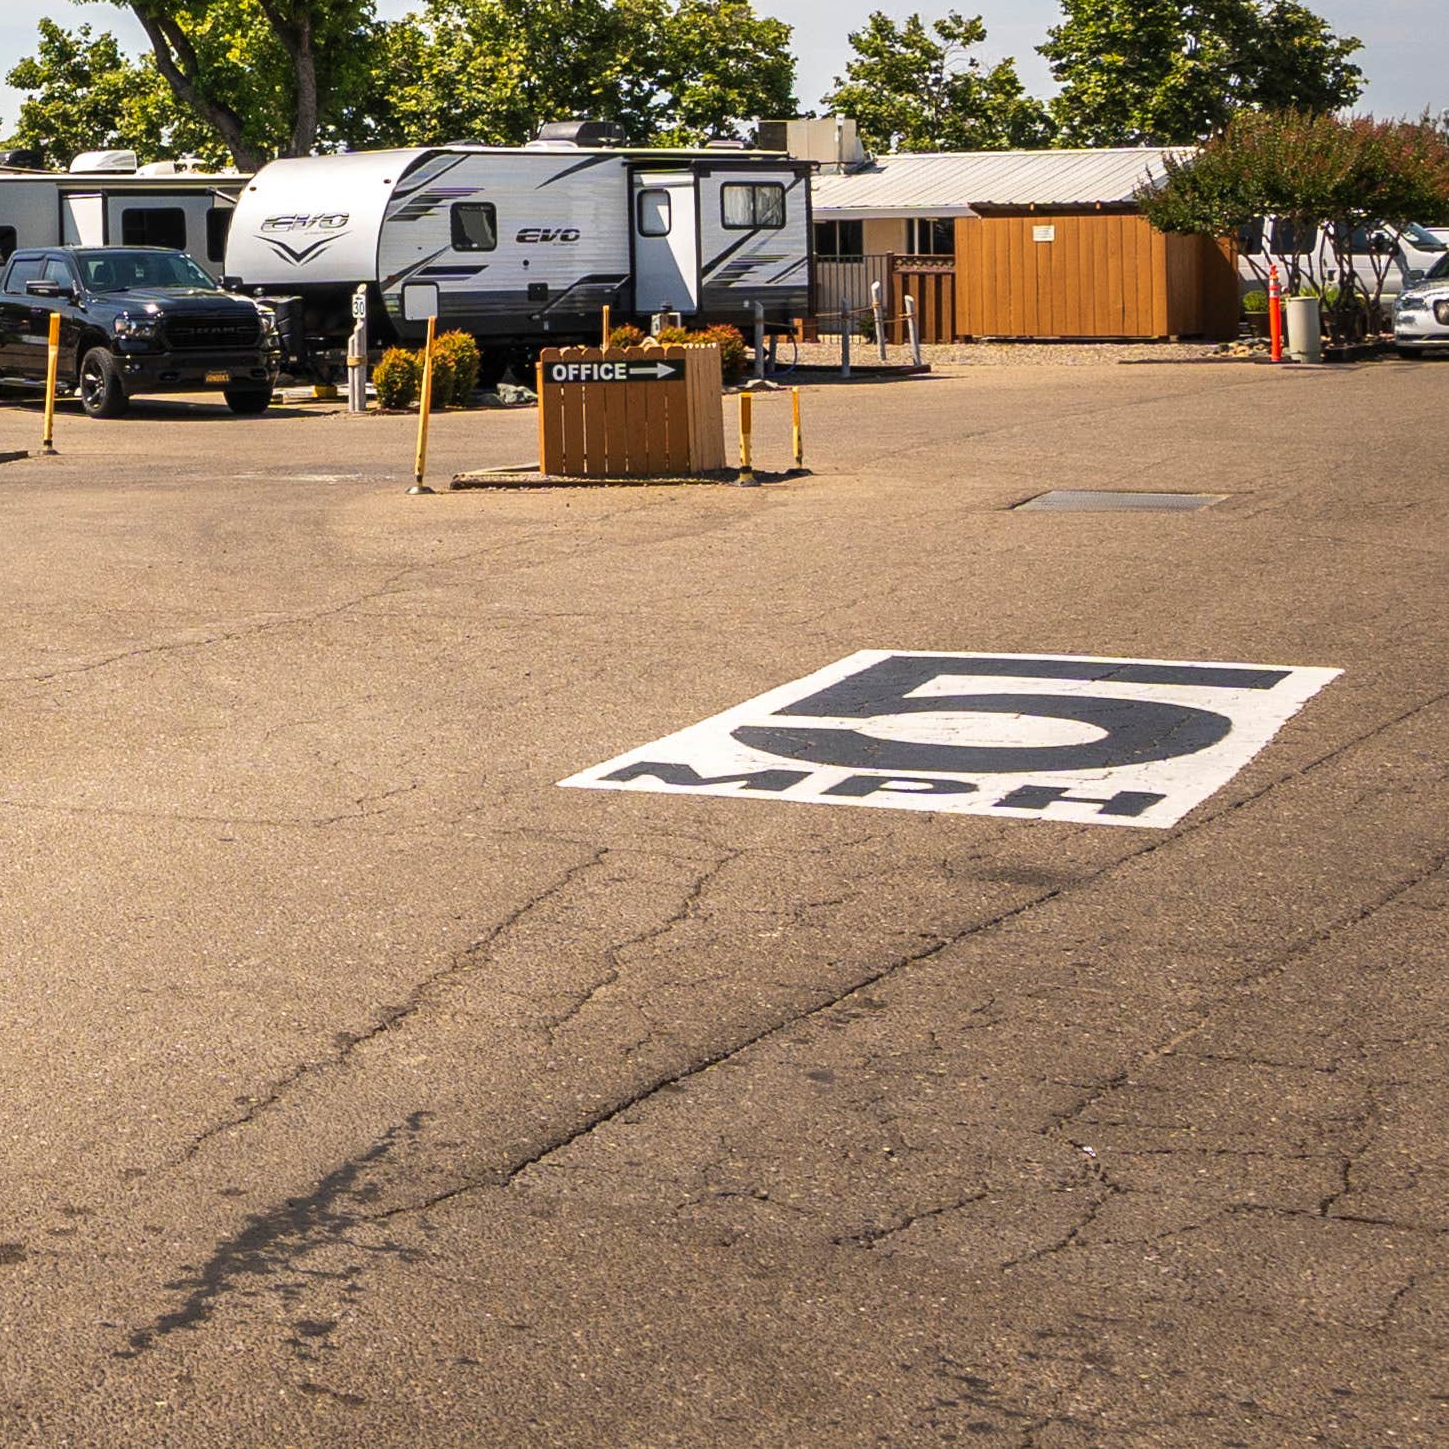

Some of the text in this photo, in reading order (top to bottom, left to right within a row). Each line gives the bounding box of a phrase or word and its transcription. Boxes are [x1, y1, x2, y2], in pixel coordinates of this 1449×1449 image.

[515, 228, 581, 243] EVO
[353, 301, 365, 316] 30
[552, 363, 627, 381] OFFICE
[729, 655, 1294, 773] 5
[598, 761, 1172, 817] MPH
